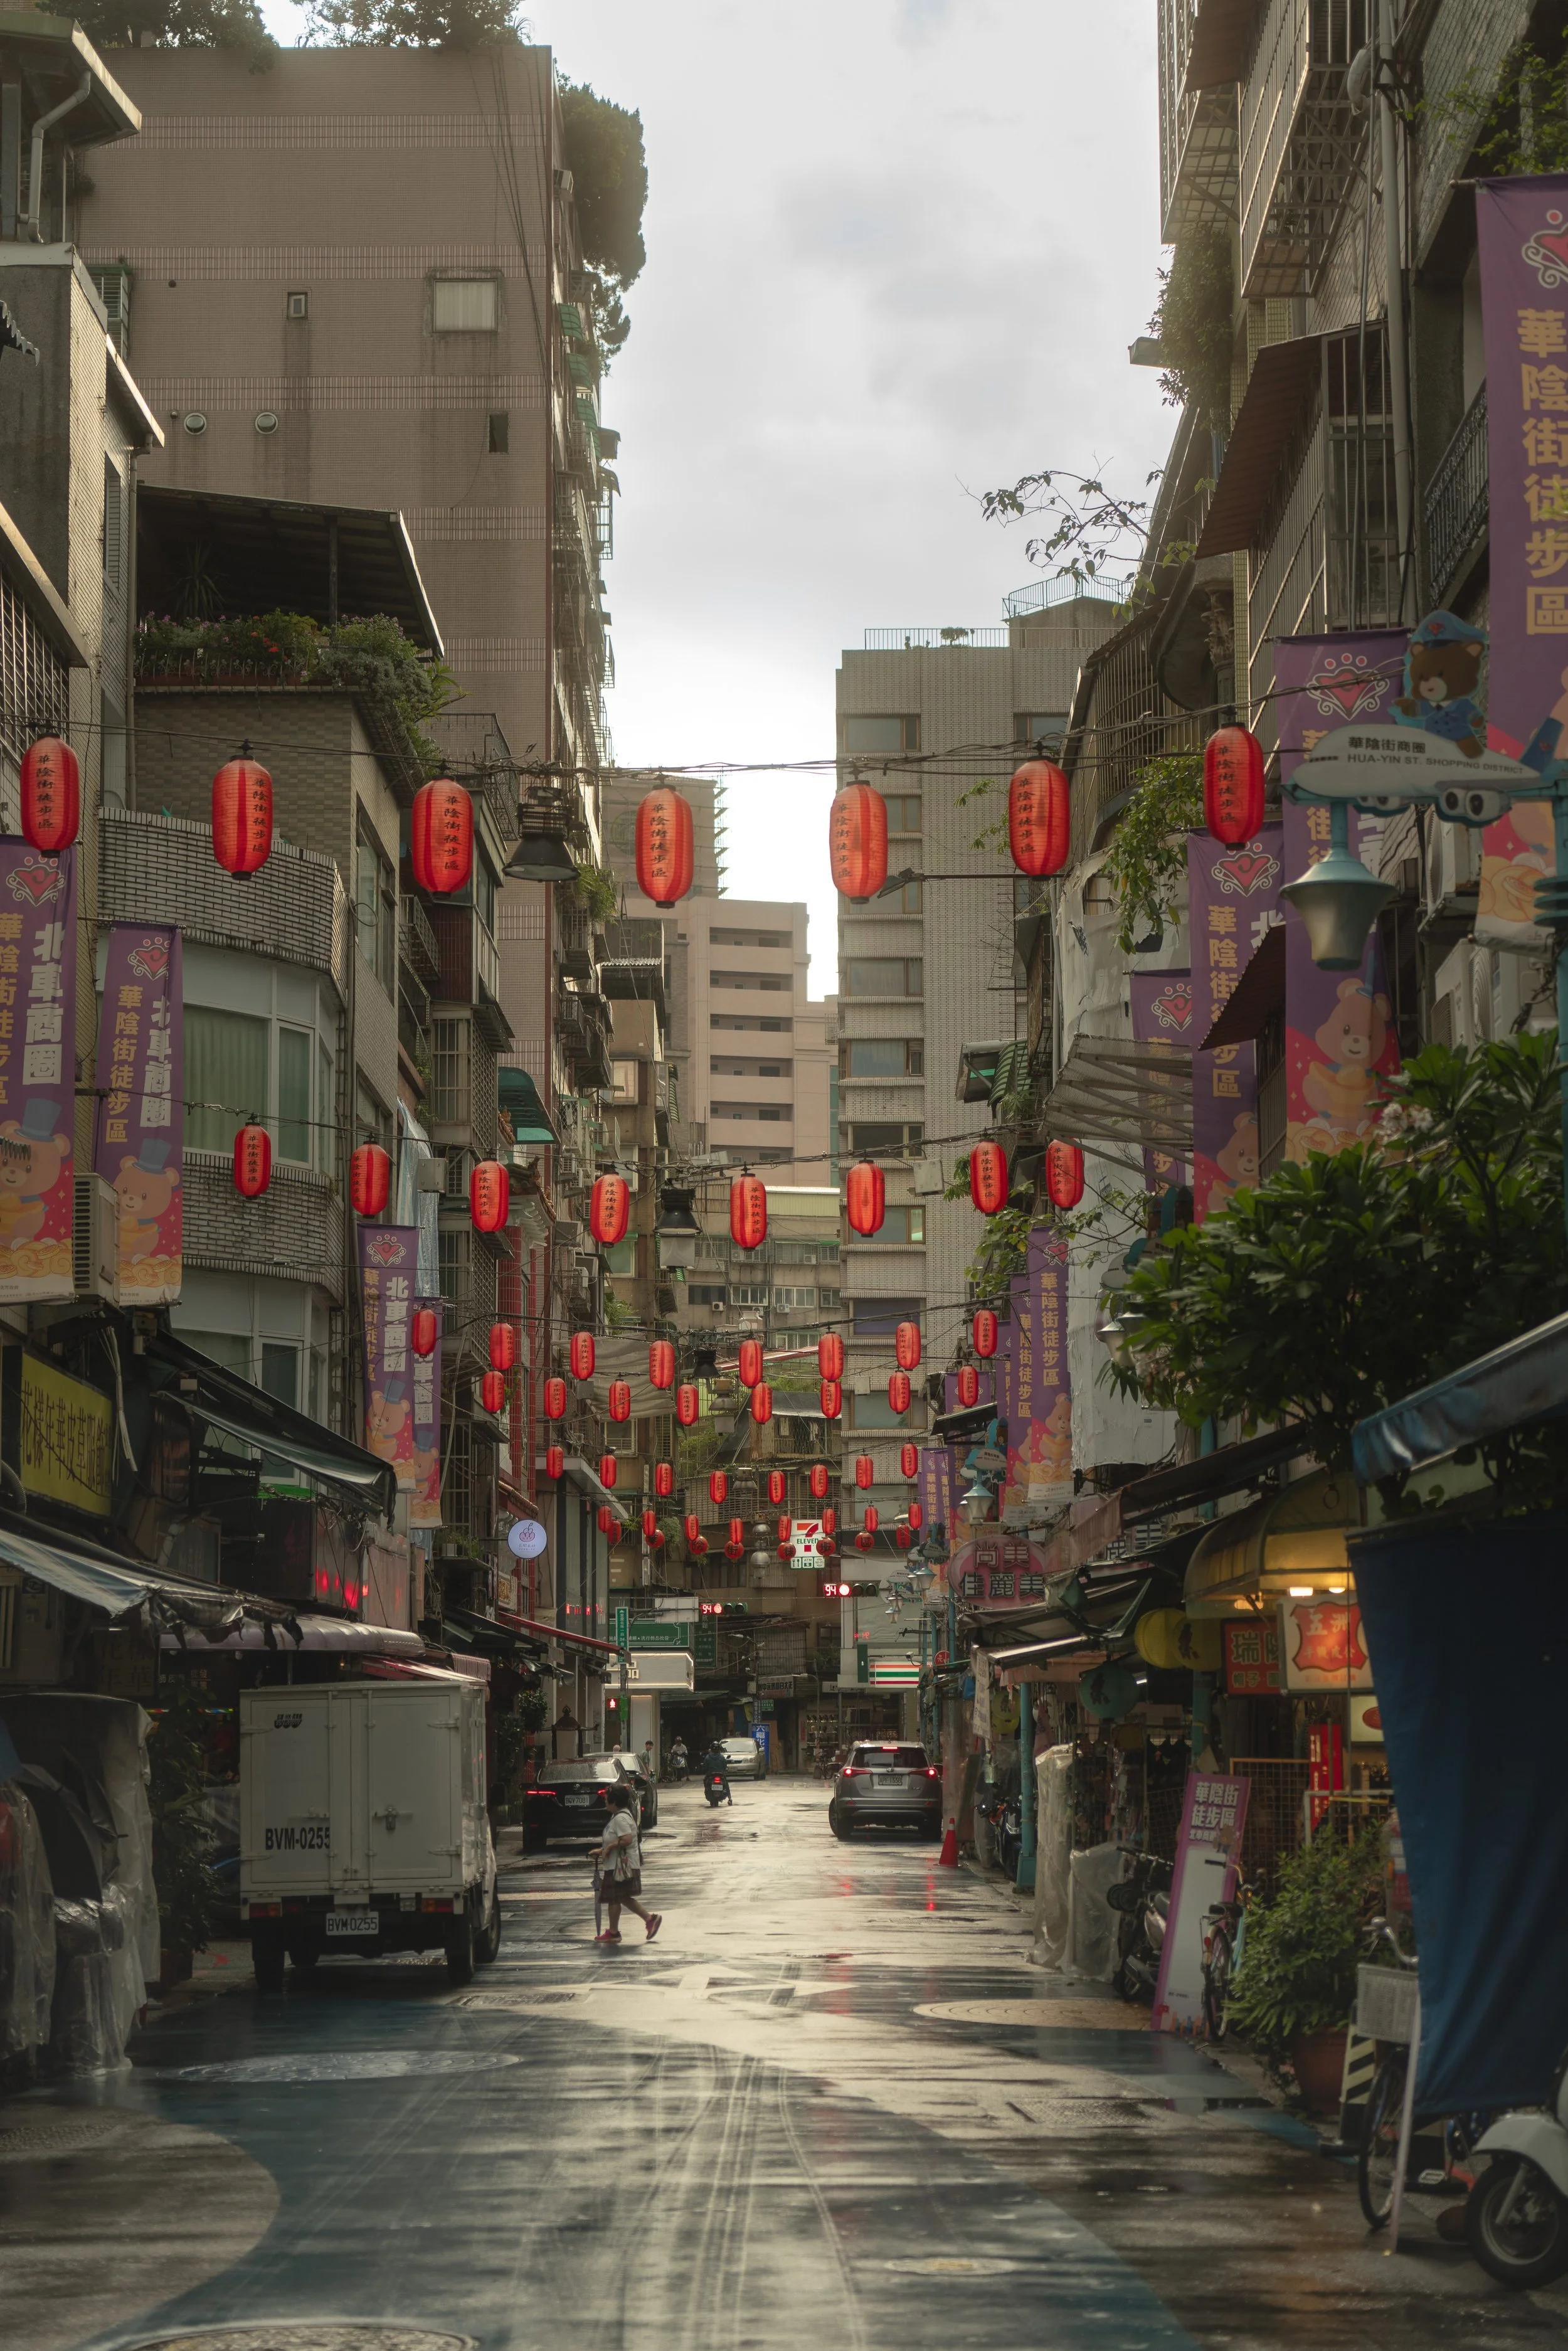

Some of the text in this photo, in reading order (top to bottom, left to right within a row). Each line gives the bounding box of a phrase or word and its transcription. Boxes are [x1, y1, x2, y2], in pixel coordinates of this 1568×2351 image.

[1517, 309, 1568, 635] 華陰街徒步區
[1348, 755, 1523, 775] HUA-YIN ST. SHOPPING DISTRICT
[1349, 736, 1426, 754] 華陰街商圈
[36, 755, 55, 829] 華陰街徒步區
[253, 778, 268, 853] 華陰街徒步區
[1017, 778, 1036, 854] 華陰街徒步區
[1216, 746, 1236, 822] 華陰街徒步區
[444, 796, 462, 871] 華陰街徒步區
[650, 804, 668, 878] 華陰街徒步區
[836, 804, 850, 878] 華陰街徒步區
[23, 921, 63, 1085] 北車商圈
[106, 985, 143, 1143] 華陰街徒步區
[384, 1276, 408, 1371] 北車商圈
[1041, 1273, 1060, 1386] 華陰街徒步區
[1018, 1313, 1032, 1418] 華陰街徒步區
[926, 1473, 937, 1526] 華陰街徒步
[825, 1584, 837, 1596] 94
[959, 1571, 1046, 1598] 佳麗美
[974, 1542, 1030, 1568] 尚美
[702, 1605, 711, 1614] 94
[756, 1725, 765, 1746] 六福化
[1192, 1804, 1236, 1829] 徒步區
[1195, 1782, 1239, 1807] 華陰街
[266, 1827, 330, 1850] BVM-0255
[328, 1918, 378, 1931] BVM-0255
